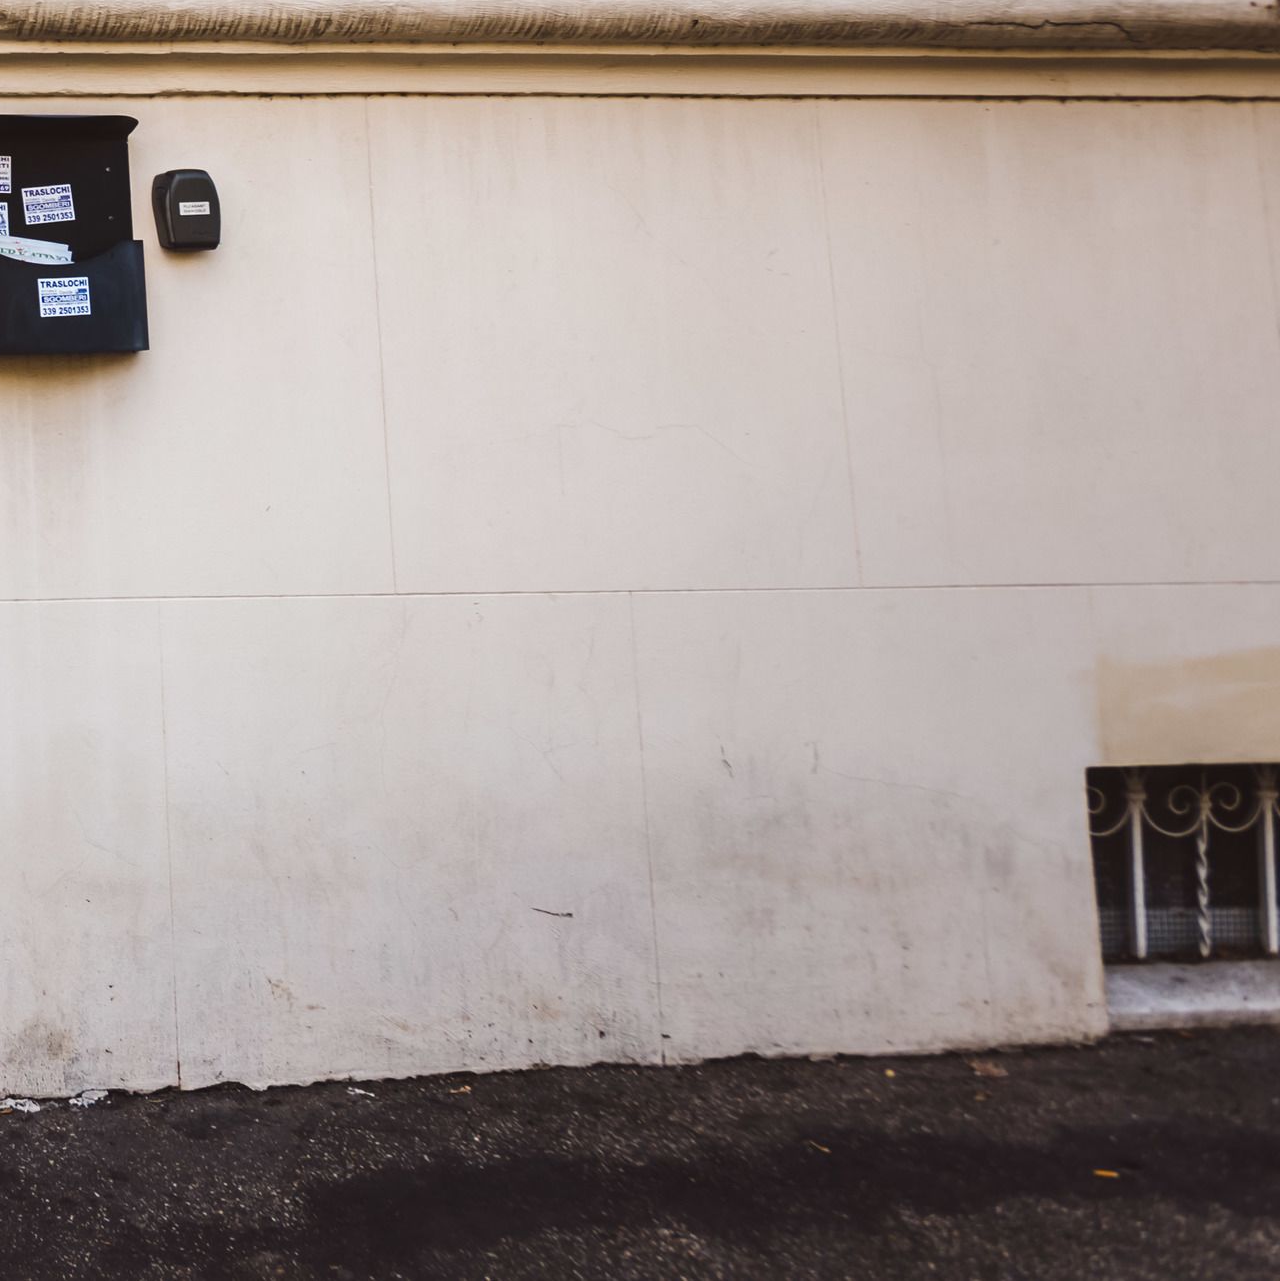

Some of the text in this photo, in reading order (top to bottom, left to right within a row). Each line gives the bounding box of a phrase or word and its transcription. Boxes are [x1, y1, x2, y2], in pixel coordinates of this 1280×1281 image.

[24, 186, 70, 197] TRASLOCHI
[27, 215, 41, 223] 339
[42, 211, 73, 222] 2501353
[40, 279, 87, 288] TRASLOCHI
[42, 305, 89, 316] 339 2501353
